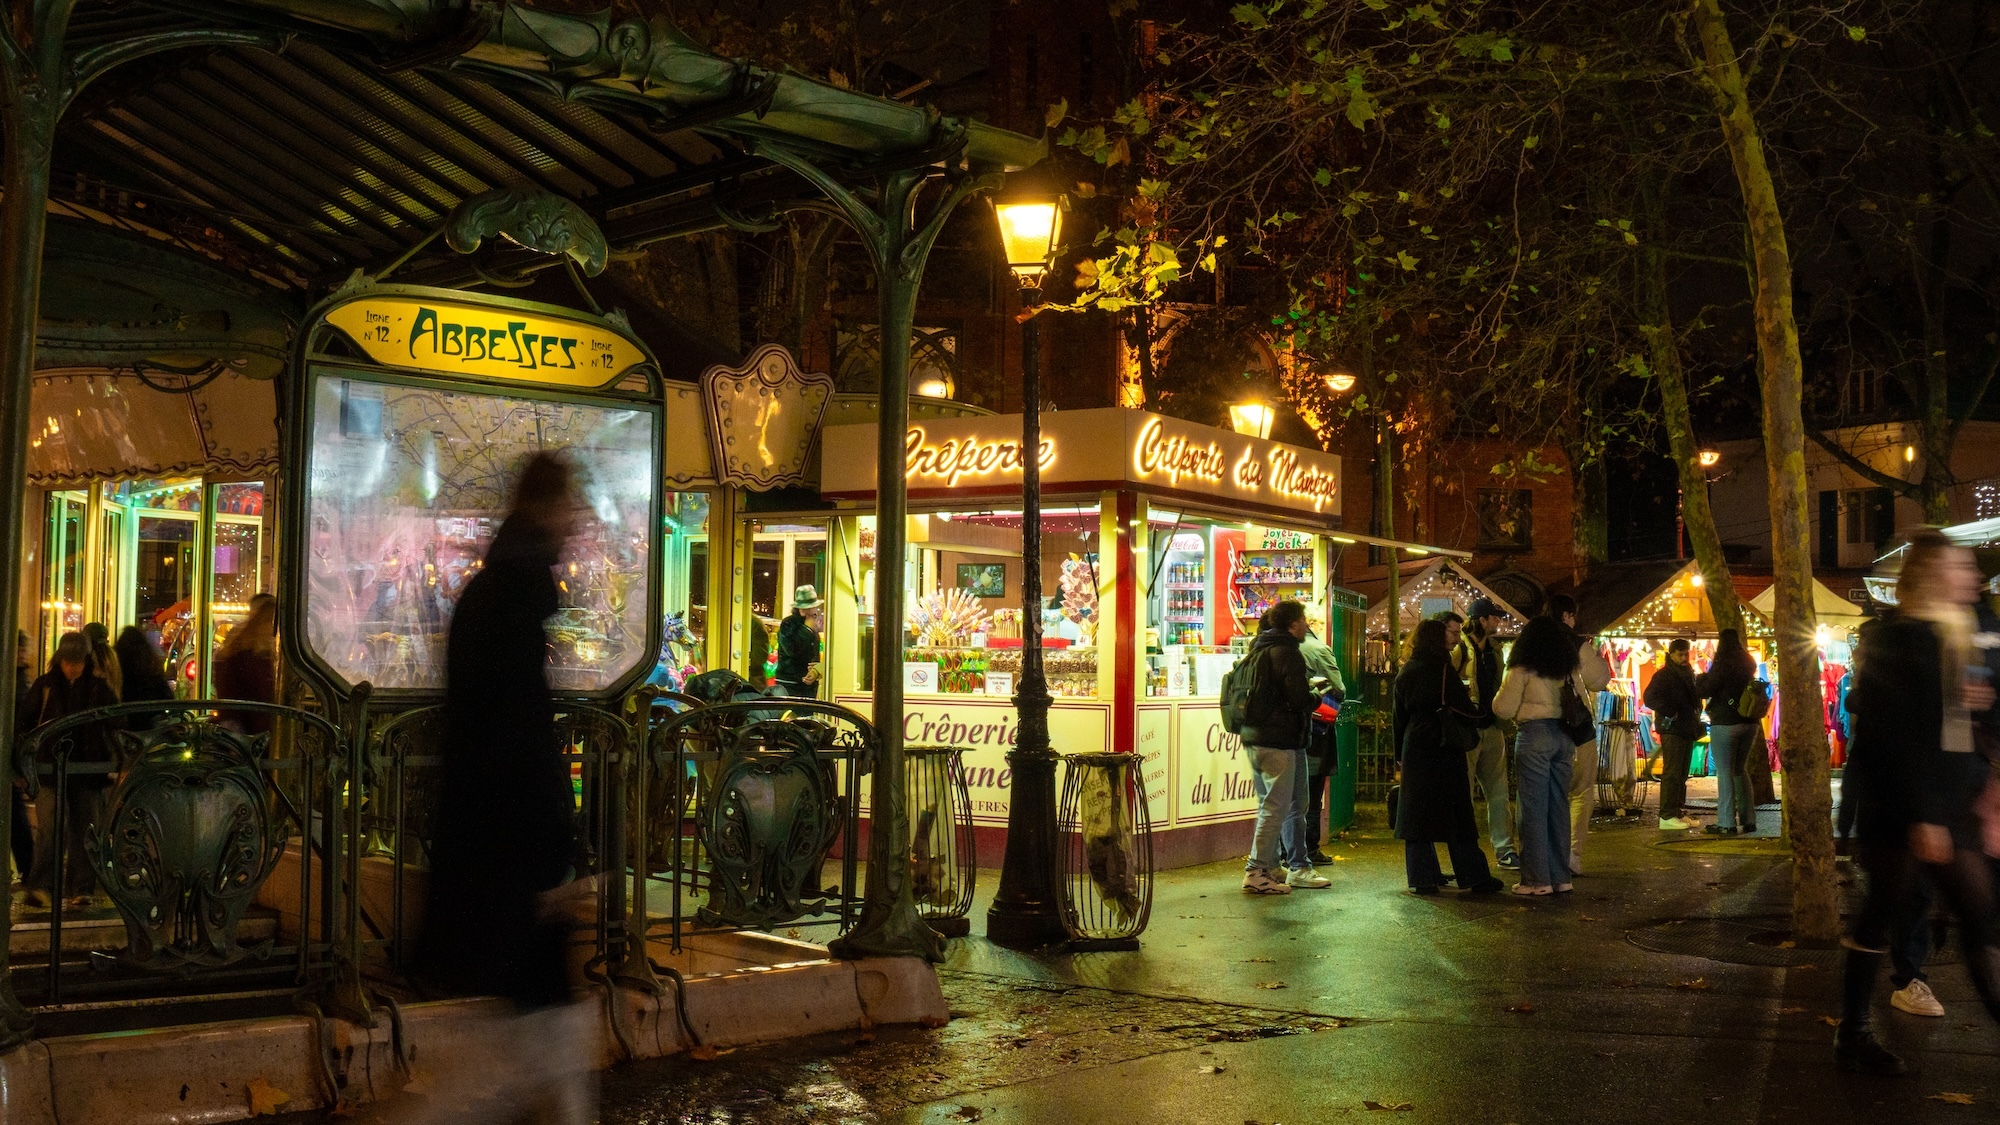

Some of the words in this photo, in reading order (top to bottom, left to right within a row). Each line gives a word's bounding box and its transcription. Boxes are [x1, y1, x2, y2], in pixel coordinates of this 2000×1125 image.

[375, 325, 390, 343] 12
[601, 353, 614, 369] 12
[1235, 445, 1264, 487] du
[1140, 728, 1156, 743] CAFÉ
[1144, 768, 1165, 785] AUFRES
[1191, 774, 1212, 806] du
[1220, 771, 1257, 802] Man
